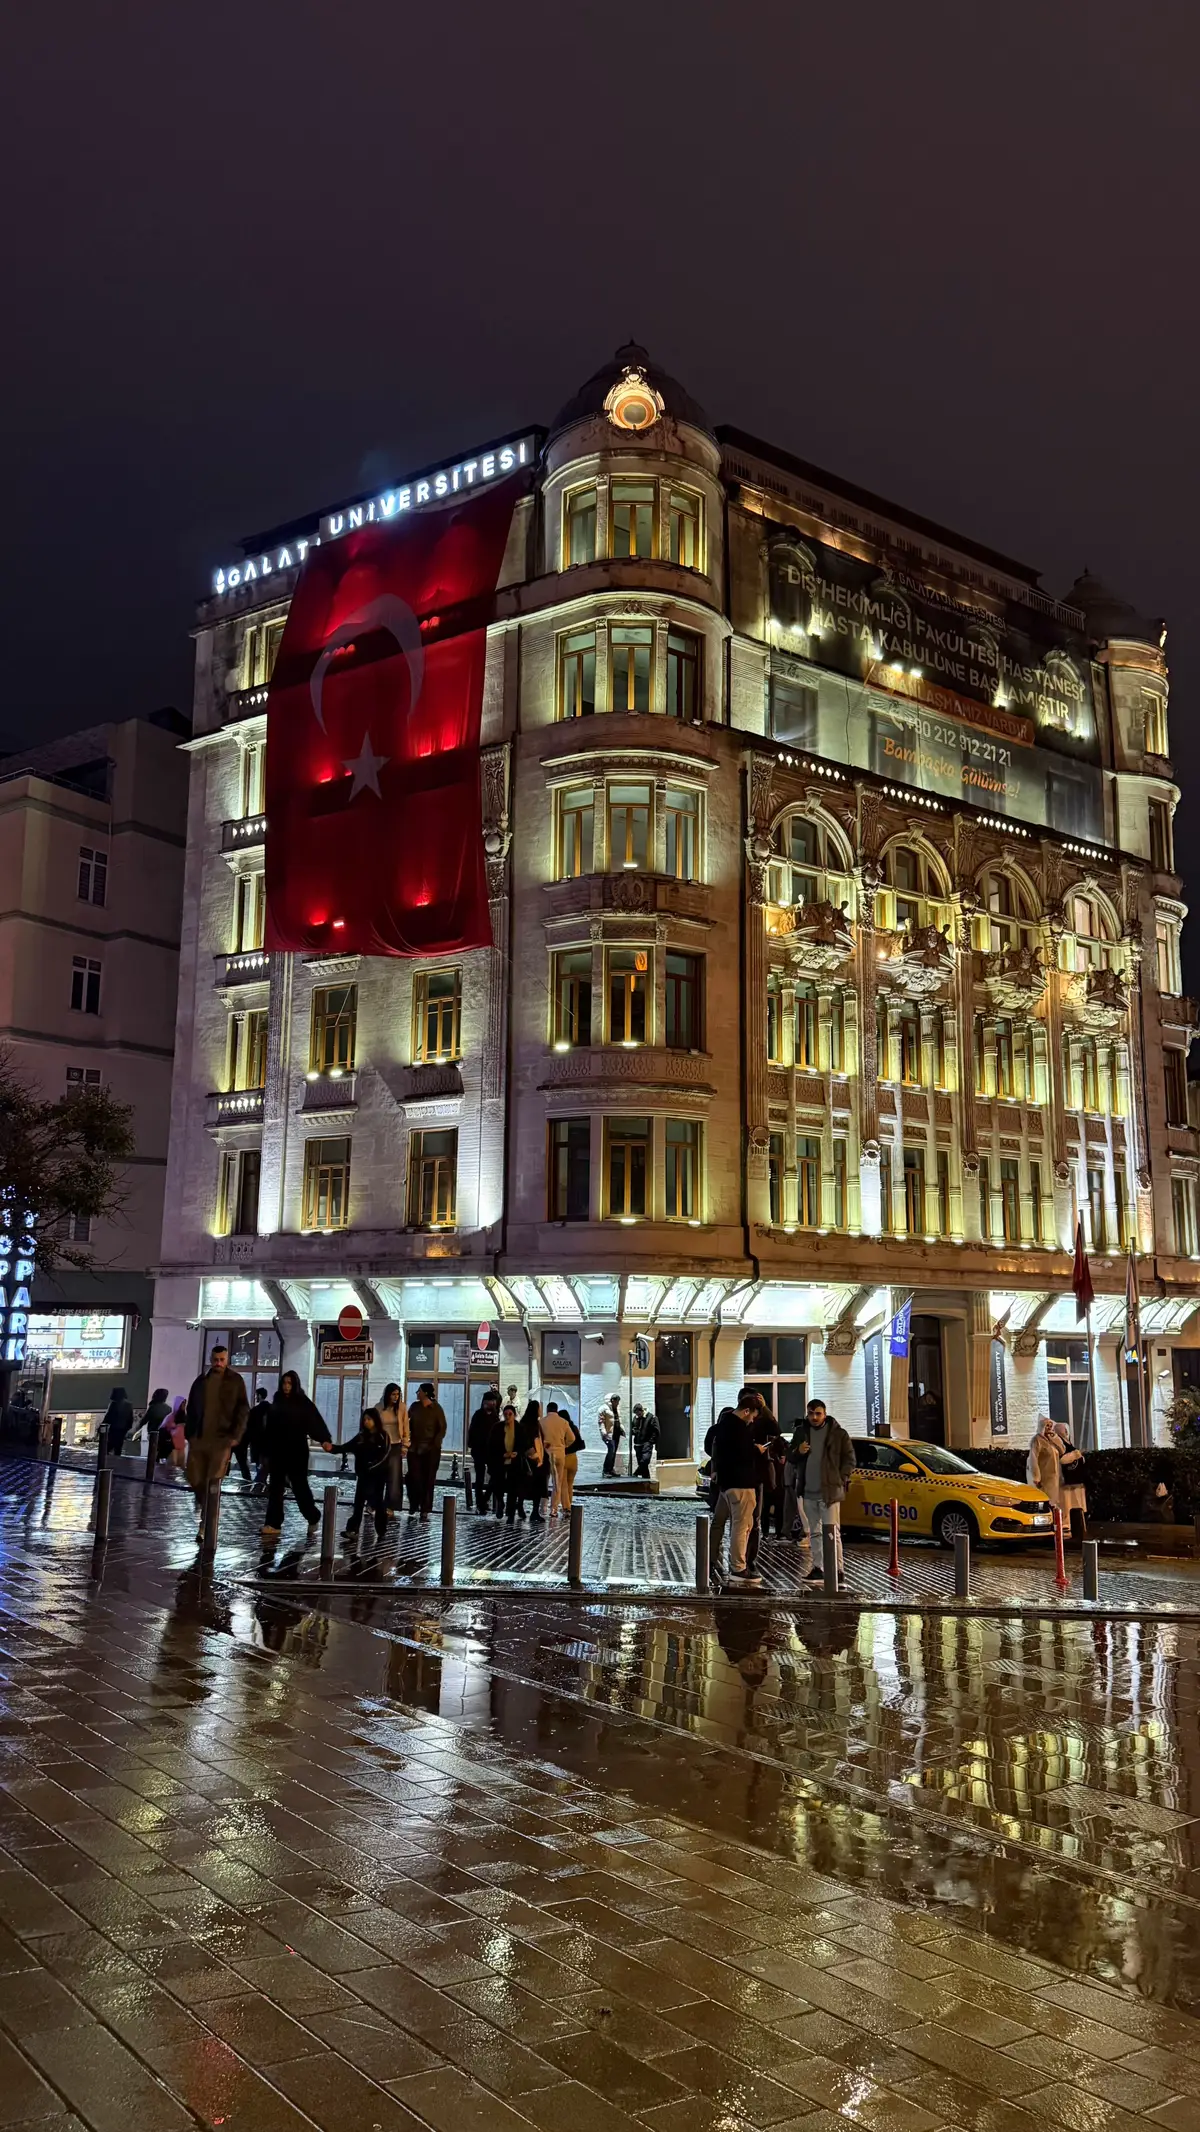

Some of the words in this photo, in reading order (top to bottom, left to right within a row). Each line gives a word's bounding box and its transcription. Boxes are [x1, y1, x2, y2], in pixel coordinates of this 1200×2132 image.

[228, 538, 321, 587] GALAT
[787, 564, 817, 599] DİŞ
[822, 581, 913, 632] HEKİMLİĞİ
[916, 616, 1000, 669] FAKÜLTESİ
[1003, 655, 1086, 703] HASTANESİ
[810, 603, 875, 645] HASTA
[878, 628, 966, 681] KABULÜNE
[908, 717, 931, 738] +90
[934, 725, 957, 749] 212
[959, 733, 981, 758] 912
[998, 749, 1012, 769] 21
[860, 1501, 891, 1518] TGS
[899, 1505, 918, 1521] 90
